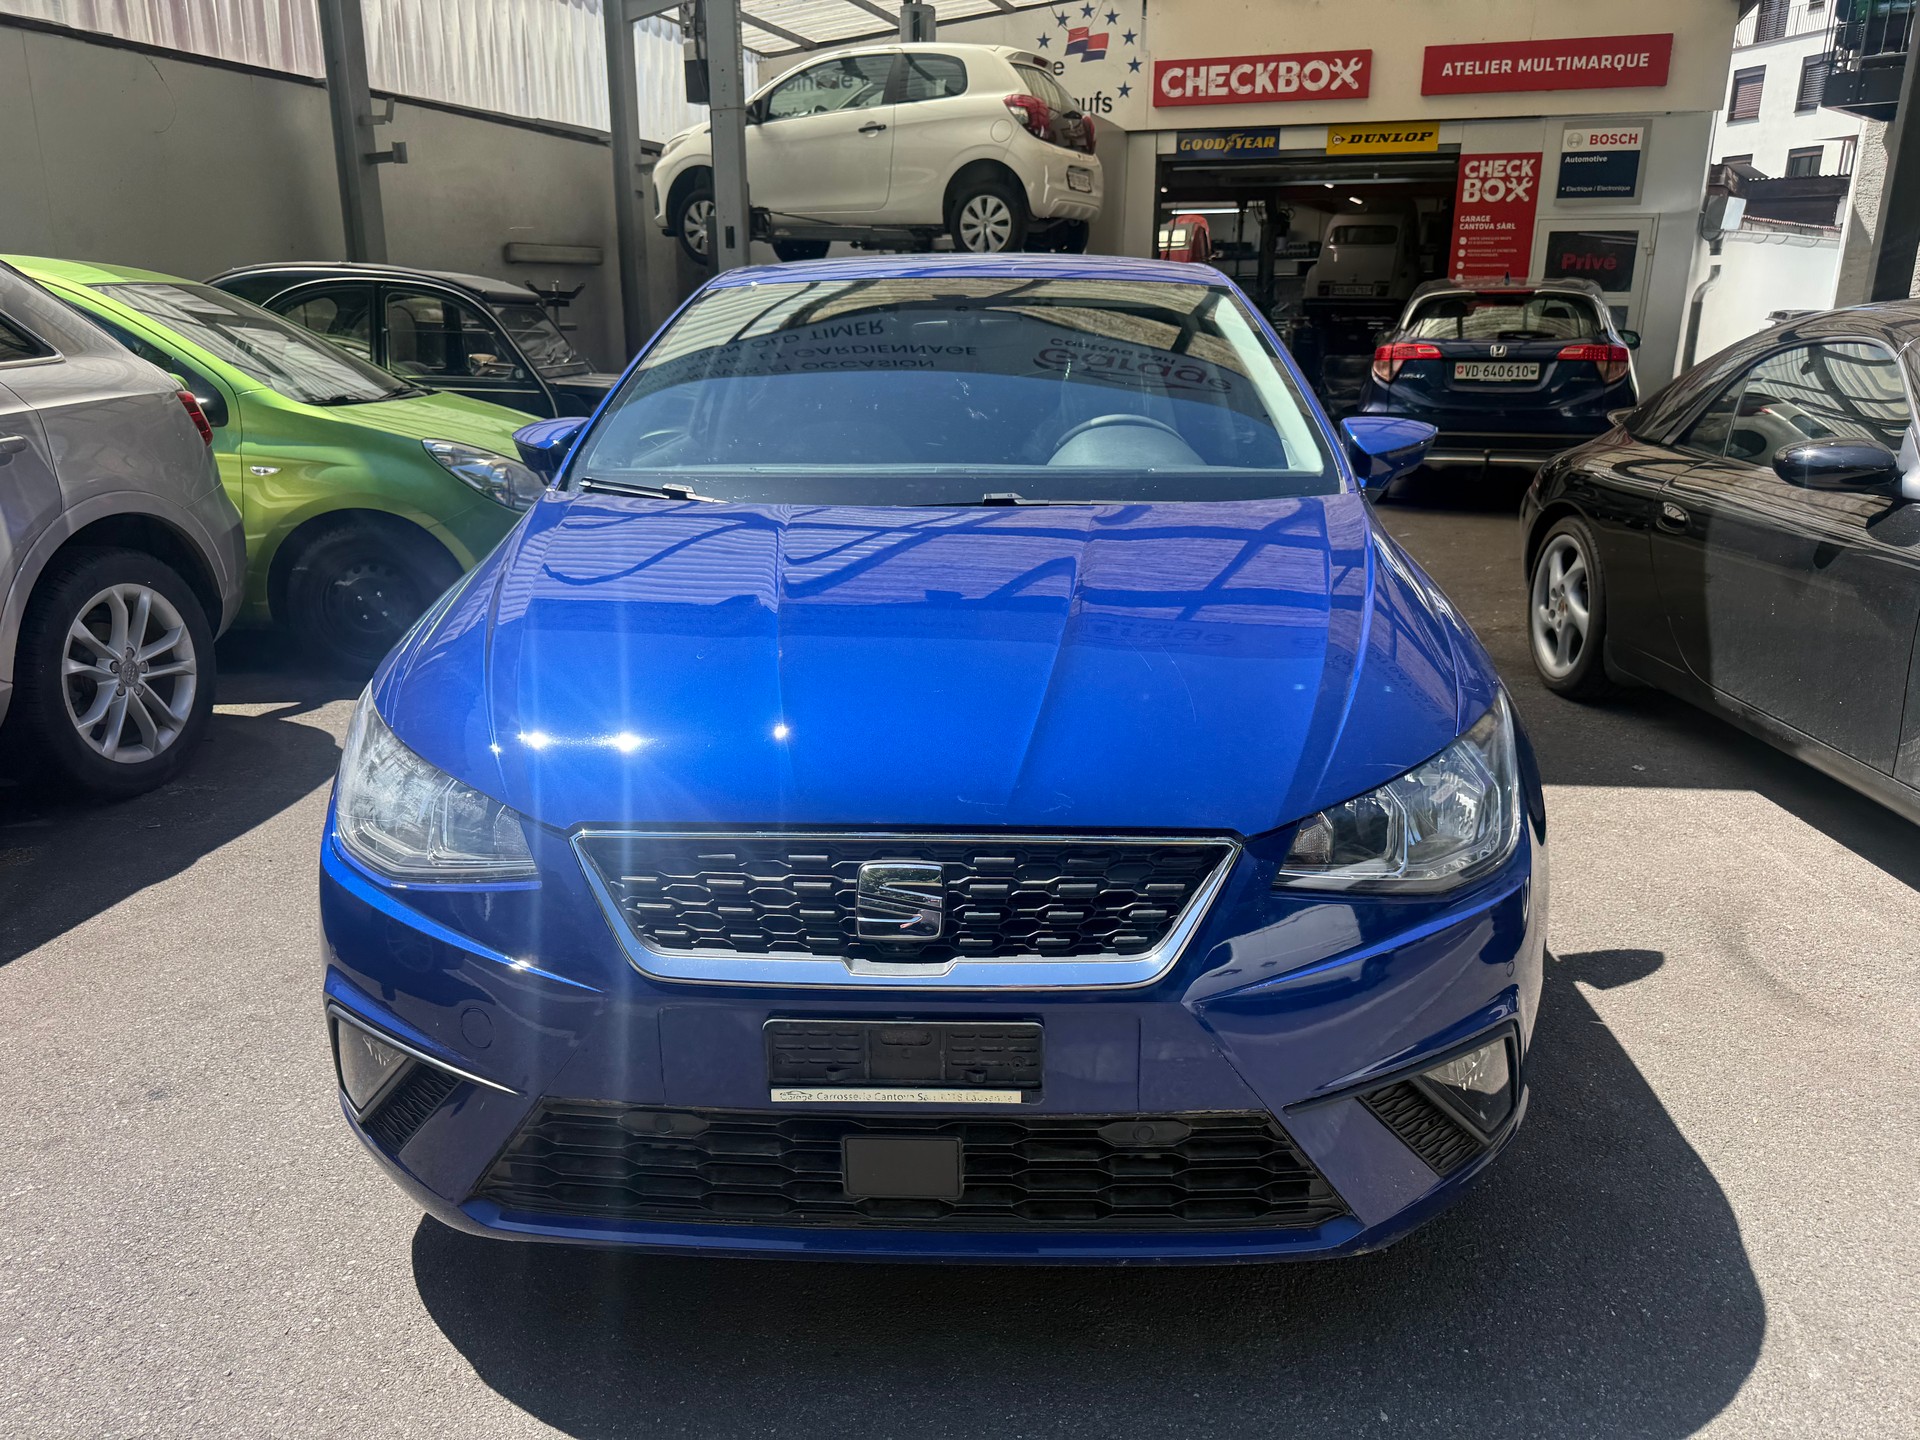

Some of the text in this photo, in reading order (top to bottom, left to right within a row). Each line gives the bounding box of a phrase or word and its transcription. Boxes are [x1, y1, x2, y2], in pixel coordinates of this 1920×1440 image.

[1442, 52, 1650, 77] ATELIER MULTIMARQUE
[1160, 56, 1363, 98] CHECKBOX
[1347, 131, 1434, 144] DUNLOP
[1589, 133, 1638, 145] BOSCH
[1464, 159, 1536, 178] CHECK
[1564, 155, 1608, 163] Automotive
[1462, 177, 1534, 203] BOX
[1460, 215, 1491, 223] GARAGE
[1561, 252, 1617, 271] Privé
